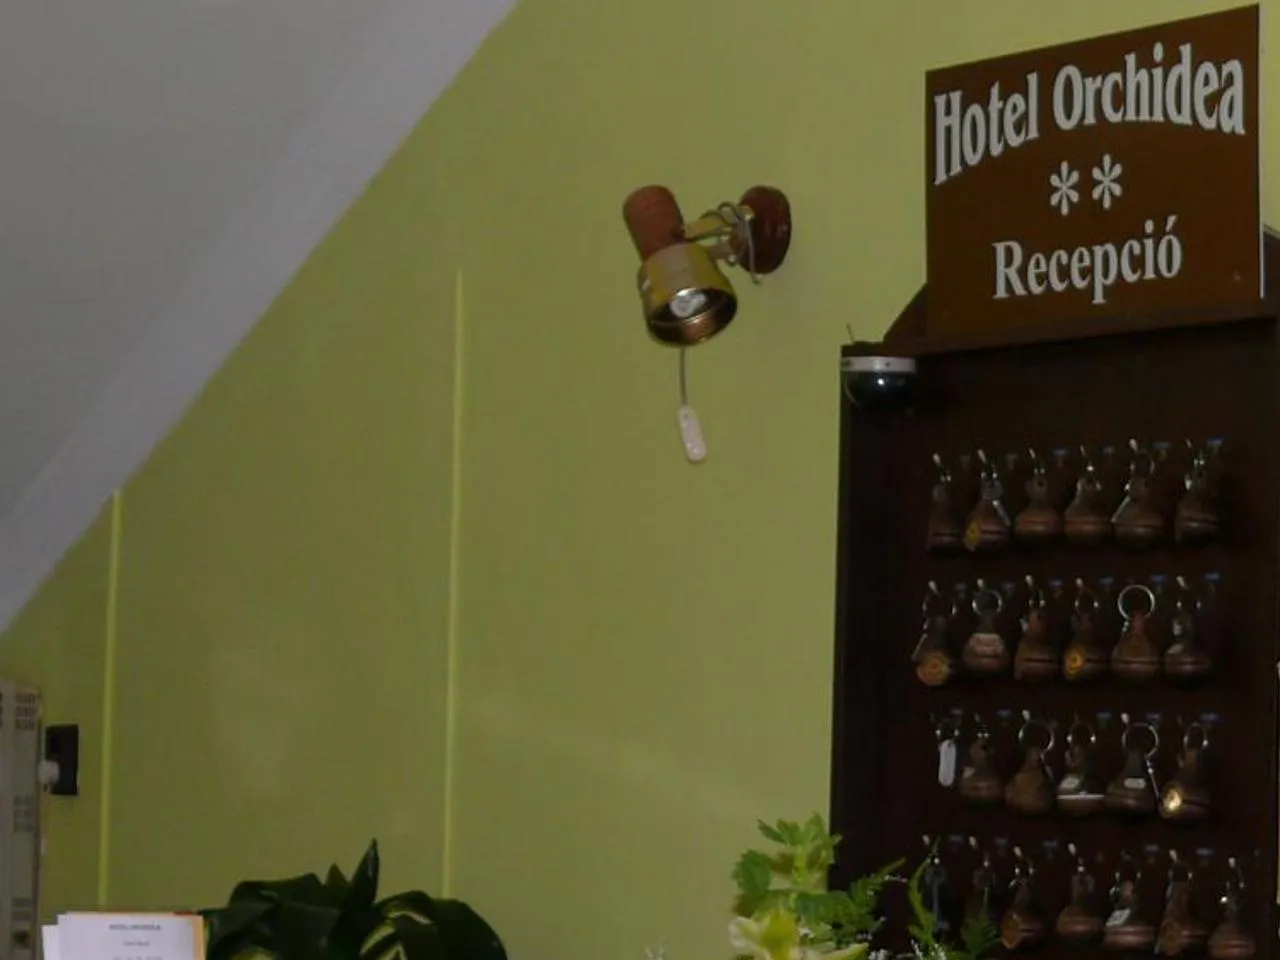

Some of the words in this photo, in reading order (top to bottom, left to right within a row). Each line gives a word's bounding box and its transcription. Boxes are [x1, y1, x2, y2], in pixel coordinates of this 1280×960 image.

[933, 72, 1040, 187] Hotel
[1052, 42, 1246, 136] Orchidea
[992, 215, 1183, 304] Recepció
